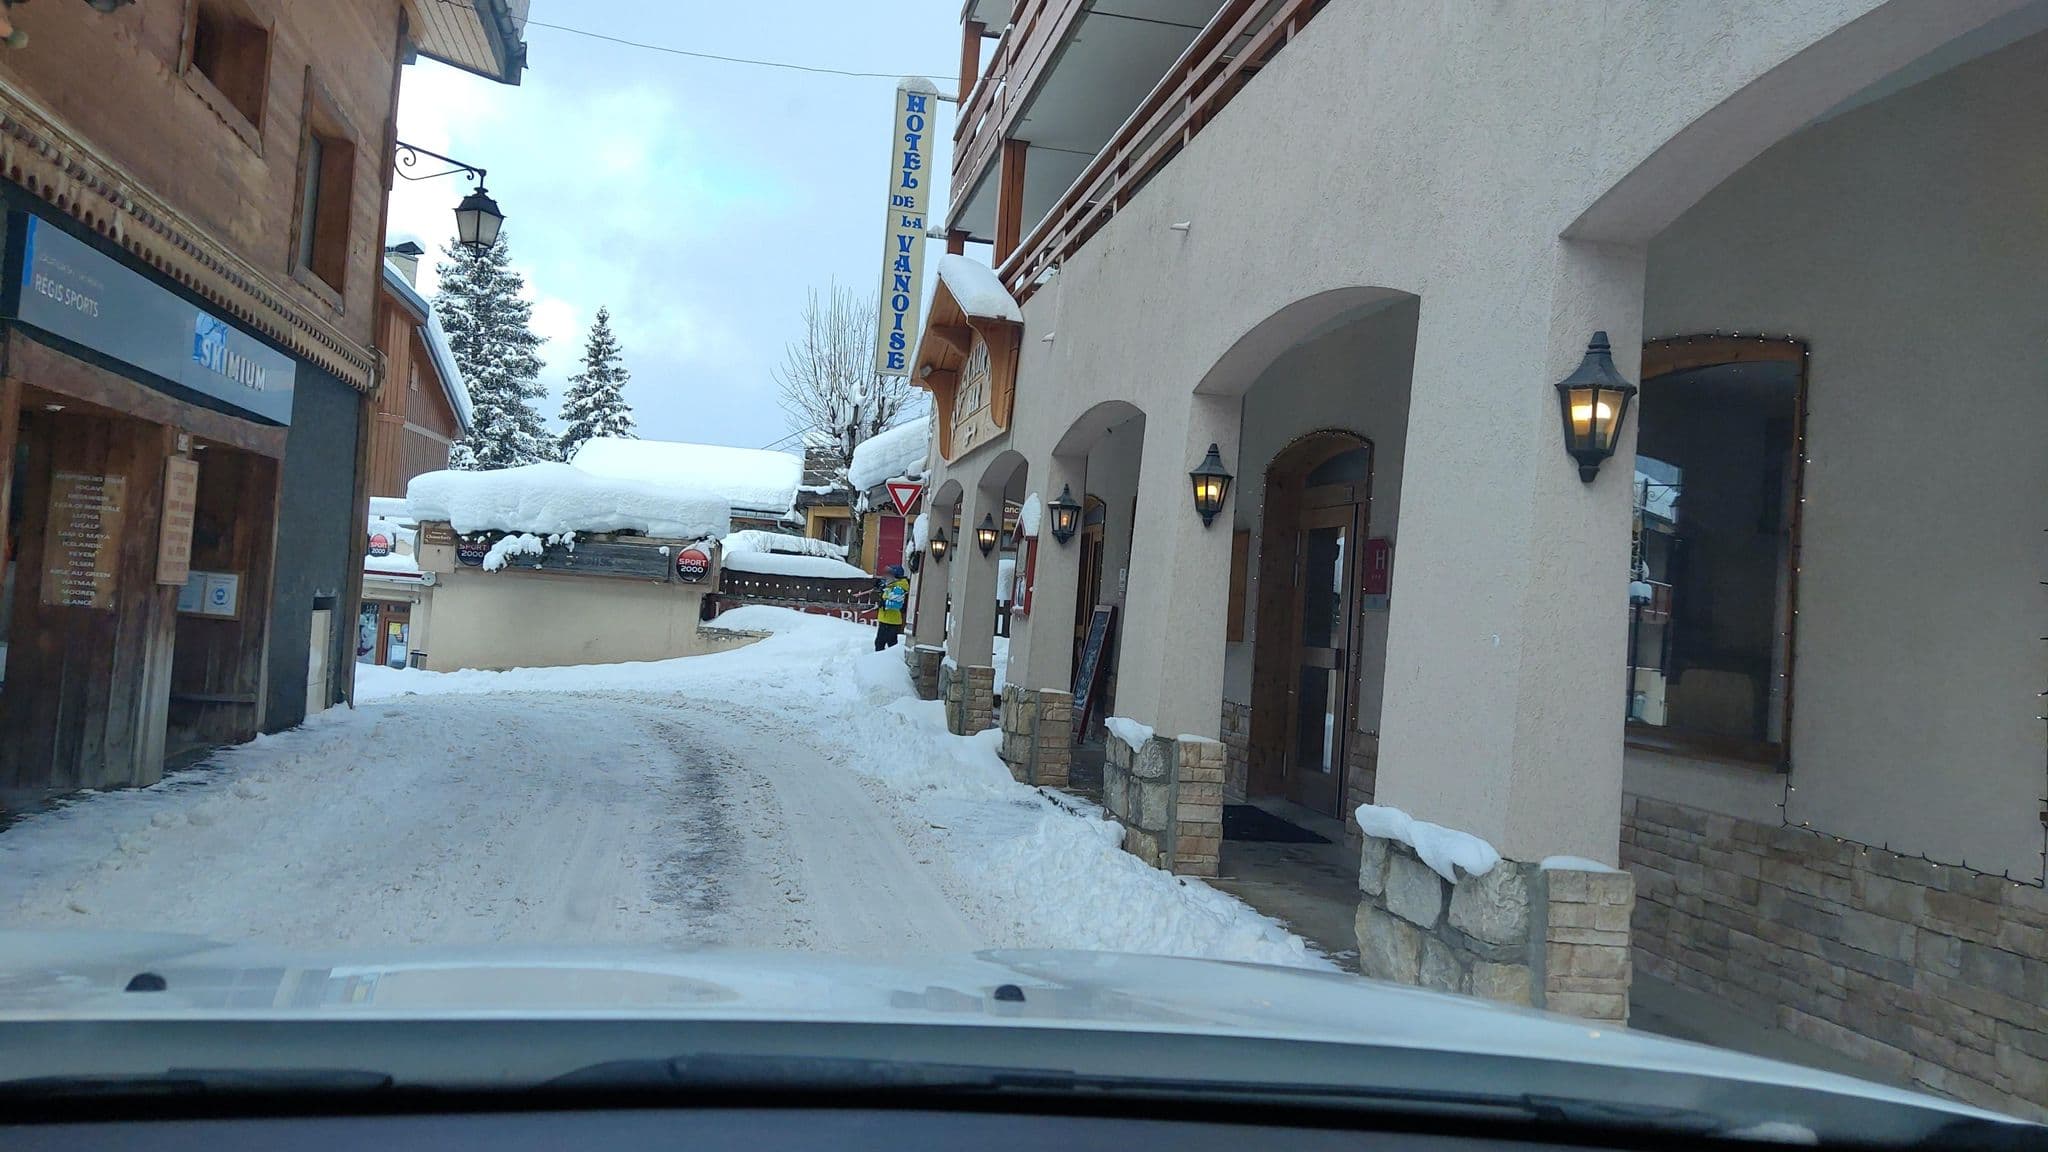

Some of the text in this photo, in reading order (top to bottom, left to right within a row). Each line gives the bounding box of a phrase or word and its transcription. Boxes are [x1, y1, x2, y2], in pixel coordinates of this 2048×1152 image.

[886, 93, 927, 370] HOTEL DE LA VANOISE
[65, 288, 99, 318] SPORTS
[201, 338, 266, 392] SKIMIUM
[62, 541, 105, 550] ICELANDIC
[461, 550, 484, 558] 2000
[678, 558, 707, 567] SPORT
[1376, 549, 1385, 570] H
[680, 565, 704, 573] 2000
[840, 610, 879, 628] Blan
